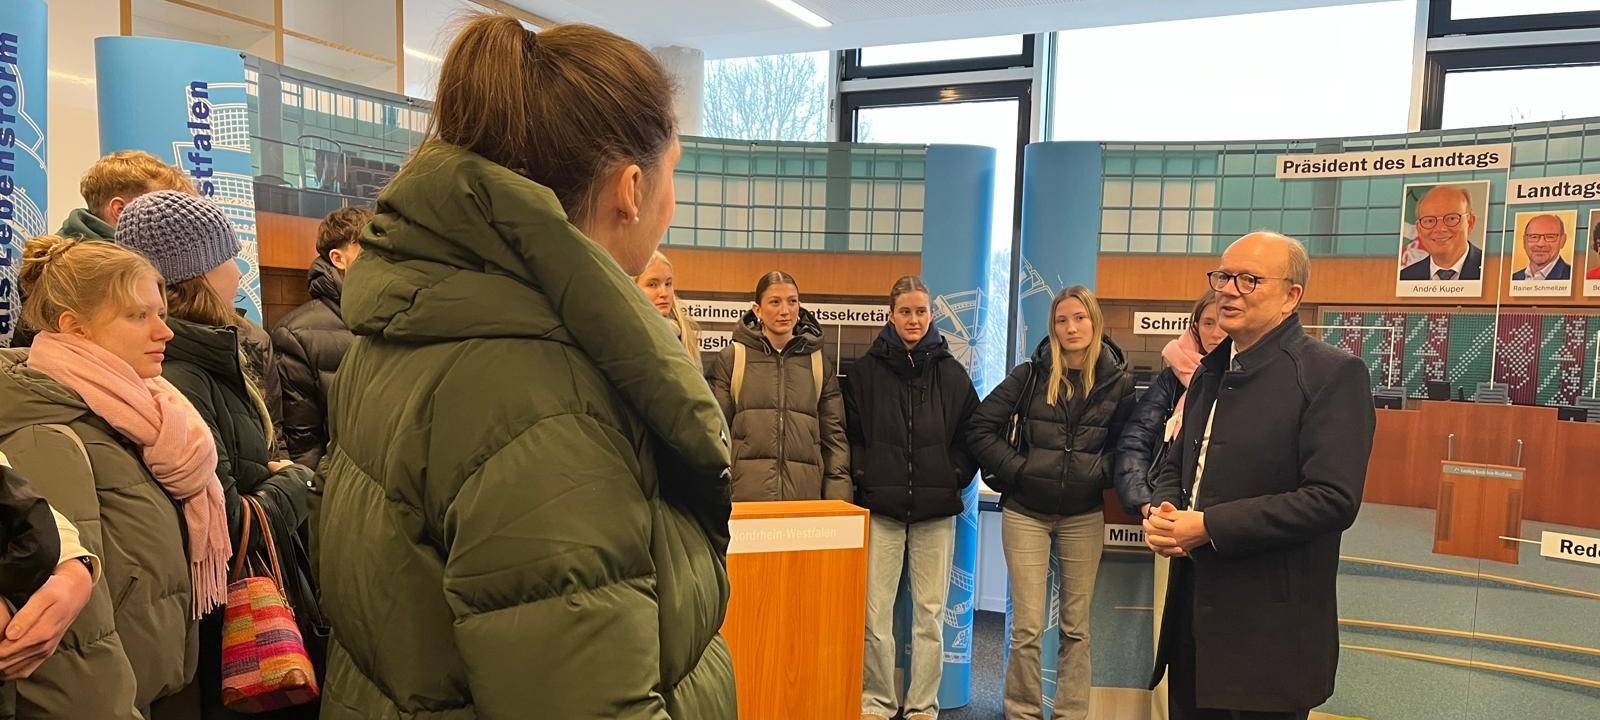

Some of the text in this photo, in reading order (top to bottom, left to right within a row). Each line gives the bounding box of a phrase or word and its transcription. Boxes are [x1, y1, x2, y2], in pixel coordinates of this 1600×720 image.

[1283, 151, 1500, 174] Präsident des Landtags
[1412, 285, 1464, 293] André Kuper
[1110, 528, 1146, 542] Mini
[1560, 538, 1600, 558] Red
